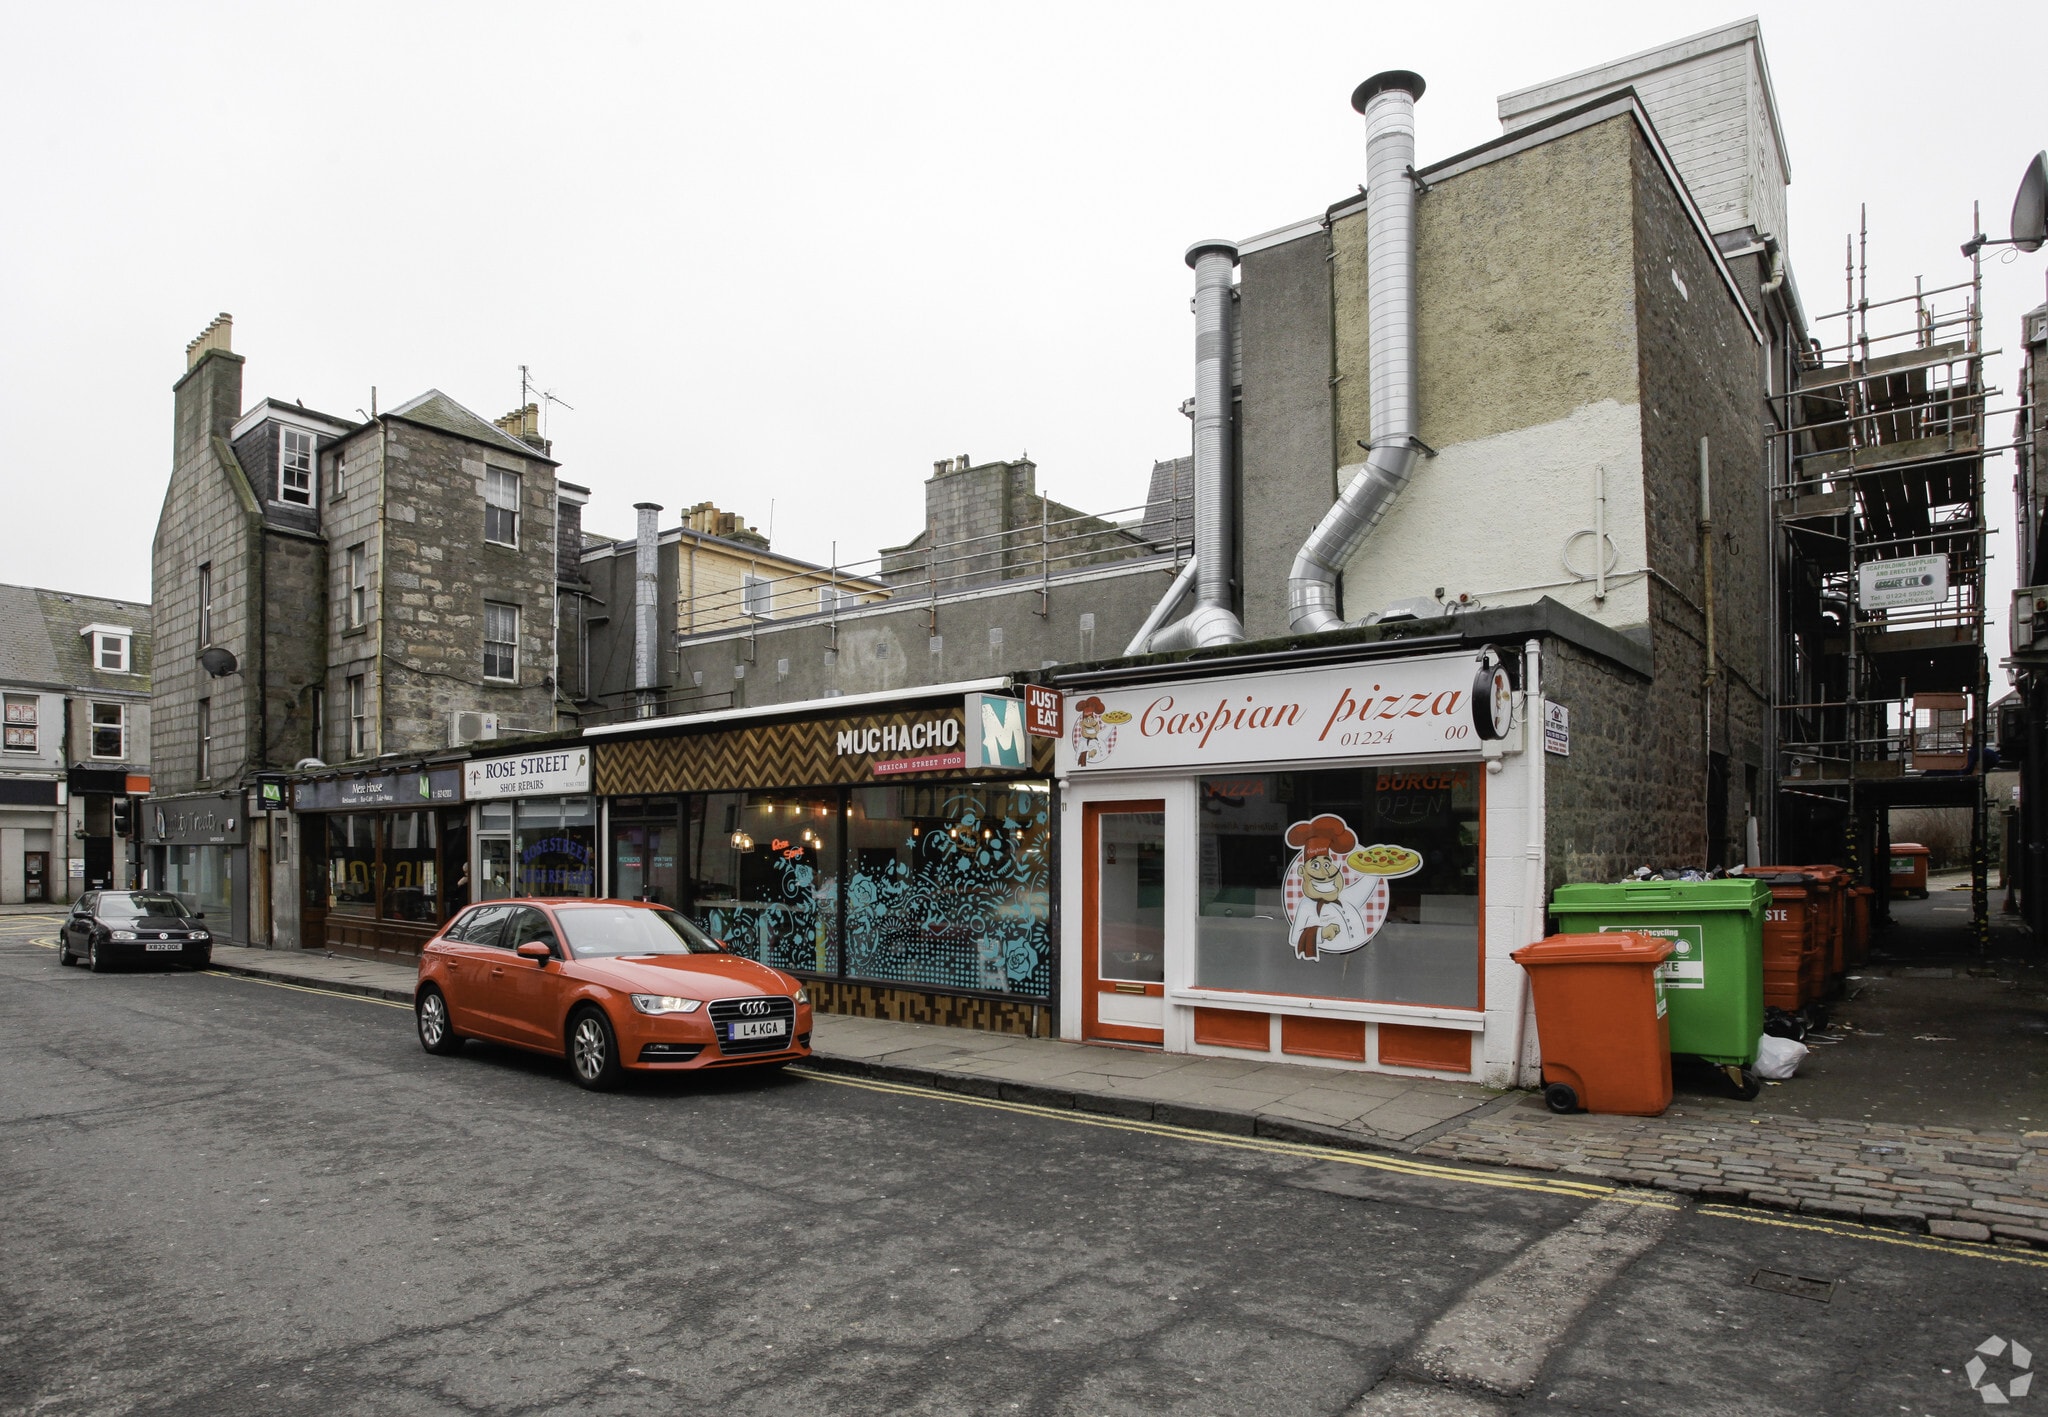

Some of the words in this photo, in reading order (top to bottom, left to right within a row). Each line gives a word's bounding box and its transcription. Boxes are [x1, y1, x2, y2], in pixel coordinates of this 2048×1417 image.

[1866, 562, 1906, 572] SCAFFOLDING
[1908, 558, 1938, 567] SUPPLIED
[1890, 568, 1917, 576] ERECTED
[1030, 690, 1058, 709] JUST
[1037, 708, 1058, 728] EAT
[1140, 695, 1308, 749] Caspian
[1318, 684, 1471, 741] pizza
[836, 718, 960, 756] MUCHACHO
[982, 700, 1026, 765] M
[1340, 728, 1396, 746] 01224
[1444, 725, 1468, 740] 00
[486, 761, 516, 779] ROSE
[521, 754, 570, 775] STREET
[878, 761, 908, 771] MEXICAN
[911, 759, 939, 768] STREET
[942, 757, 961, 765] FOOD
[352, 784, 366, 794] Meze
[366, 782, 382, 793] House
[500, 782, 516, 793] SHOE
[518, 780, 544, 792] REPAIRS
[1208, 780, 1264, 797] PIZZA
[1376, 769, 1469, 791] BURGER
[263, 785, 279, 798] M
[1377, 795, 1442, 815] OPEN
[522, 838, 548, 864] ROSE
[549, 837, 589, 865] STREET
[1644, 929, 1679, 937] Recycling
[743, 1024, 757, 1036] L4
[760, 1022, 777, 1035] KGA
